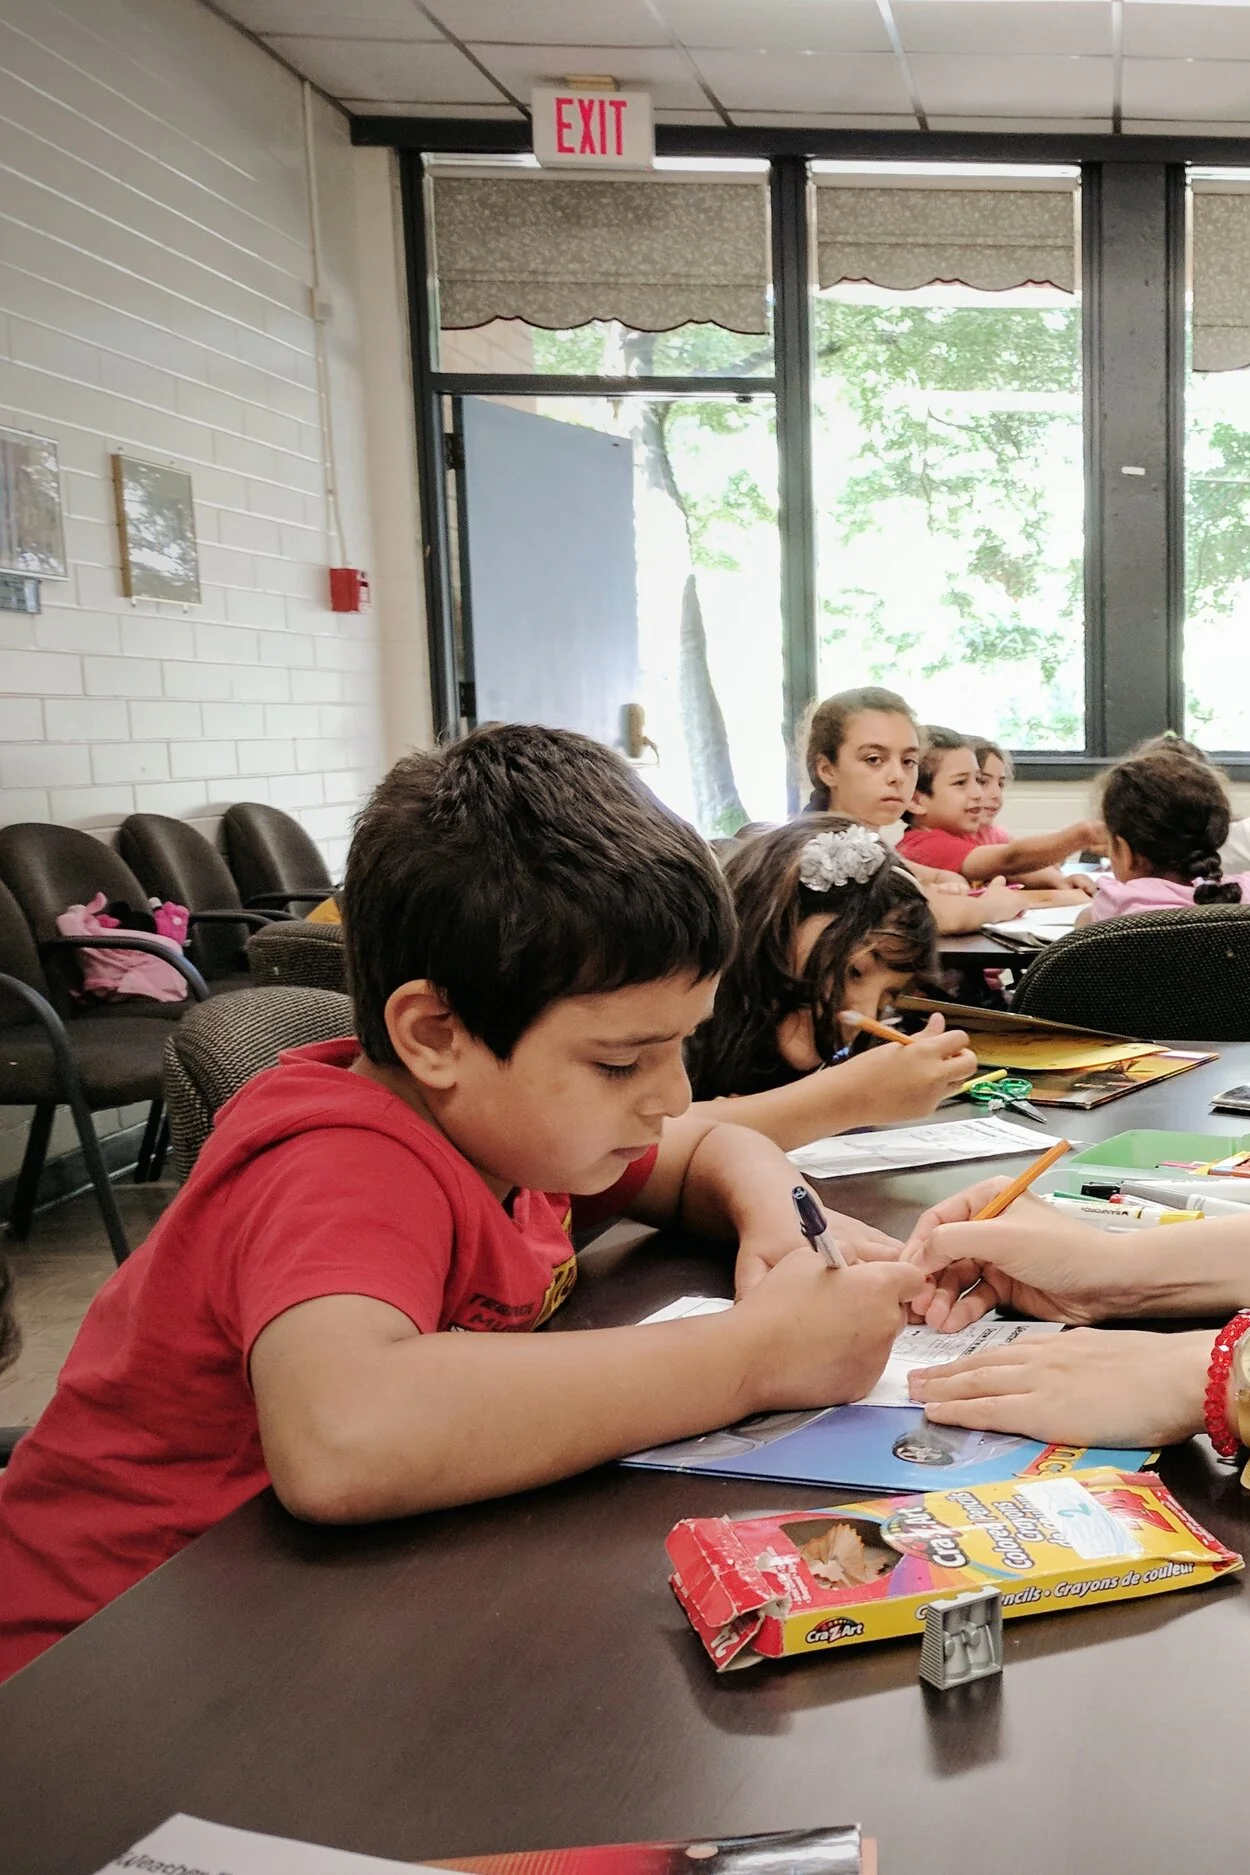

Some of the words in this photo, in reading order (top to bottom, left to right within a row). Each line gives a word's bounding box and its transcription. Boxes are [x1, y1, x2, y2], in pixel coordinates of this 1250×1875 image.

[555, 98, 628, 156] EXIT
[946, 1491, 997, 1527] Pencils
[993, 1500, 1045, 1543] Crayons
[980, 1521, 1035, 1569] Colored
[1002, 1586, 1042, 1606] ncils
[1054, 1575, 1118, 1598] Crayons
[1121, 1572, 1141, 1588] de
[1142, 1561, 1196, 1583] couleur
[710, 1624, 740, 1658] 24
